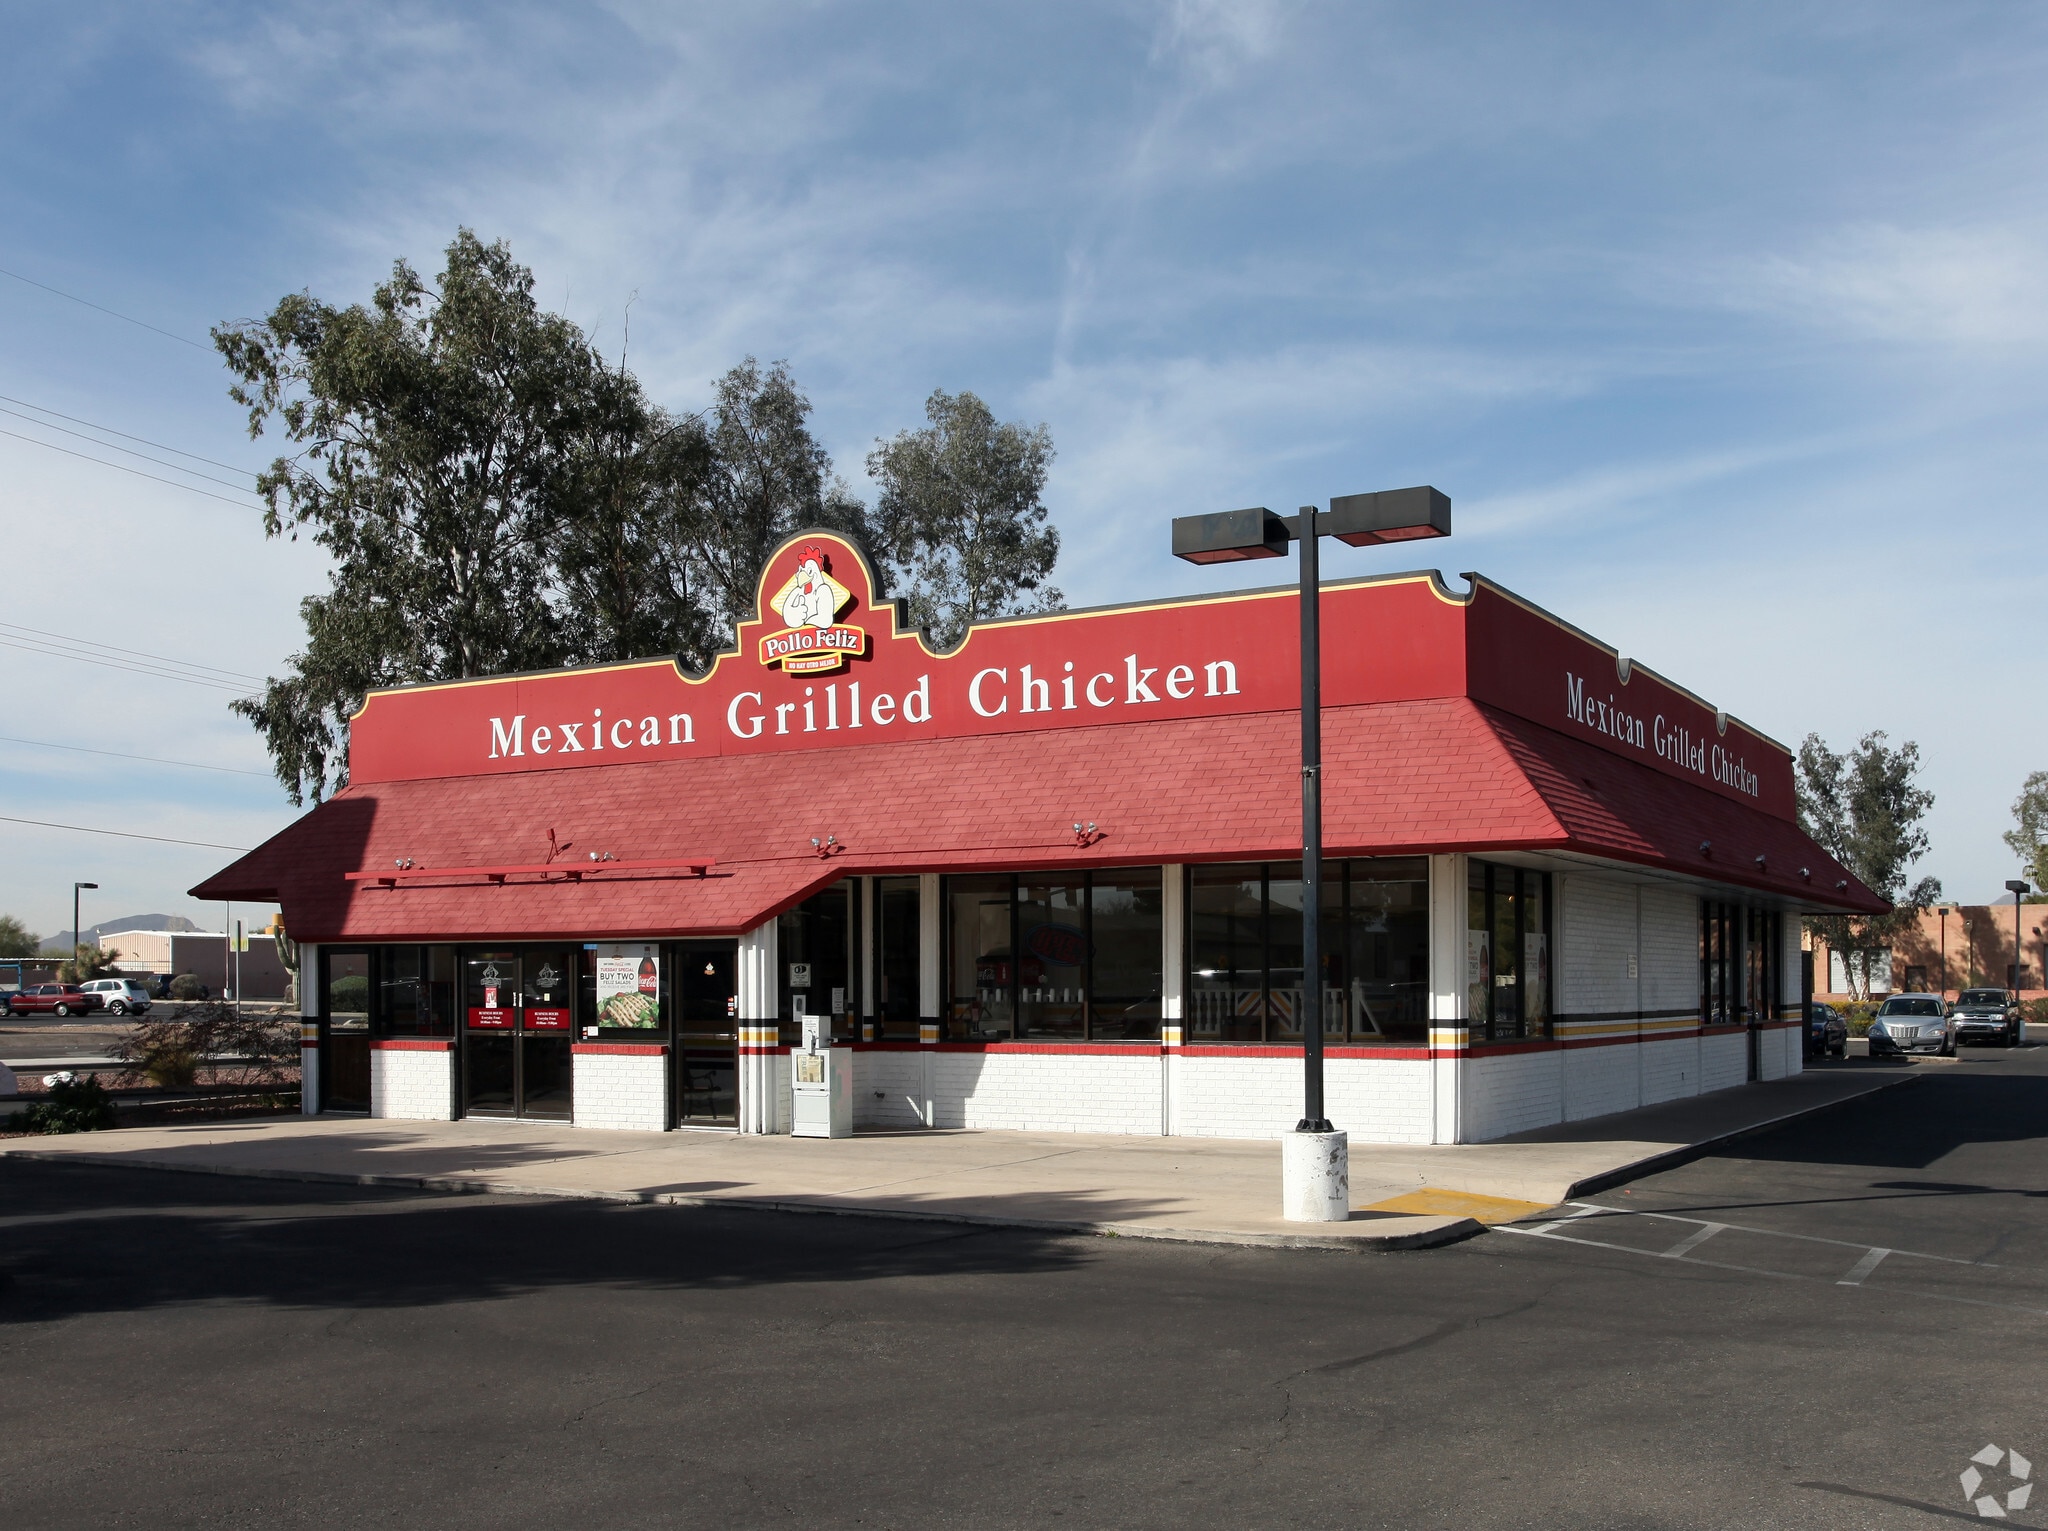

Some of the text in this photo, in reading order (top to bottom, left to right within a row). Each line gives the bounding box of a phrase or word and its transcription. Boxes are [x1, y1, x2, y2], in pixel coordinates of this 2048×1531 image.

[766, 630, 857, 657] Pollo Feliz
[489, 653, 1240, 759] Mexican Grilled Chicken
[1566, 671, 1759, 798] Mexican Grilled Chicken
